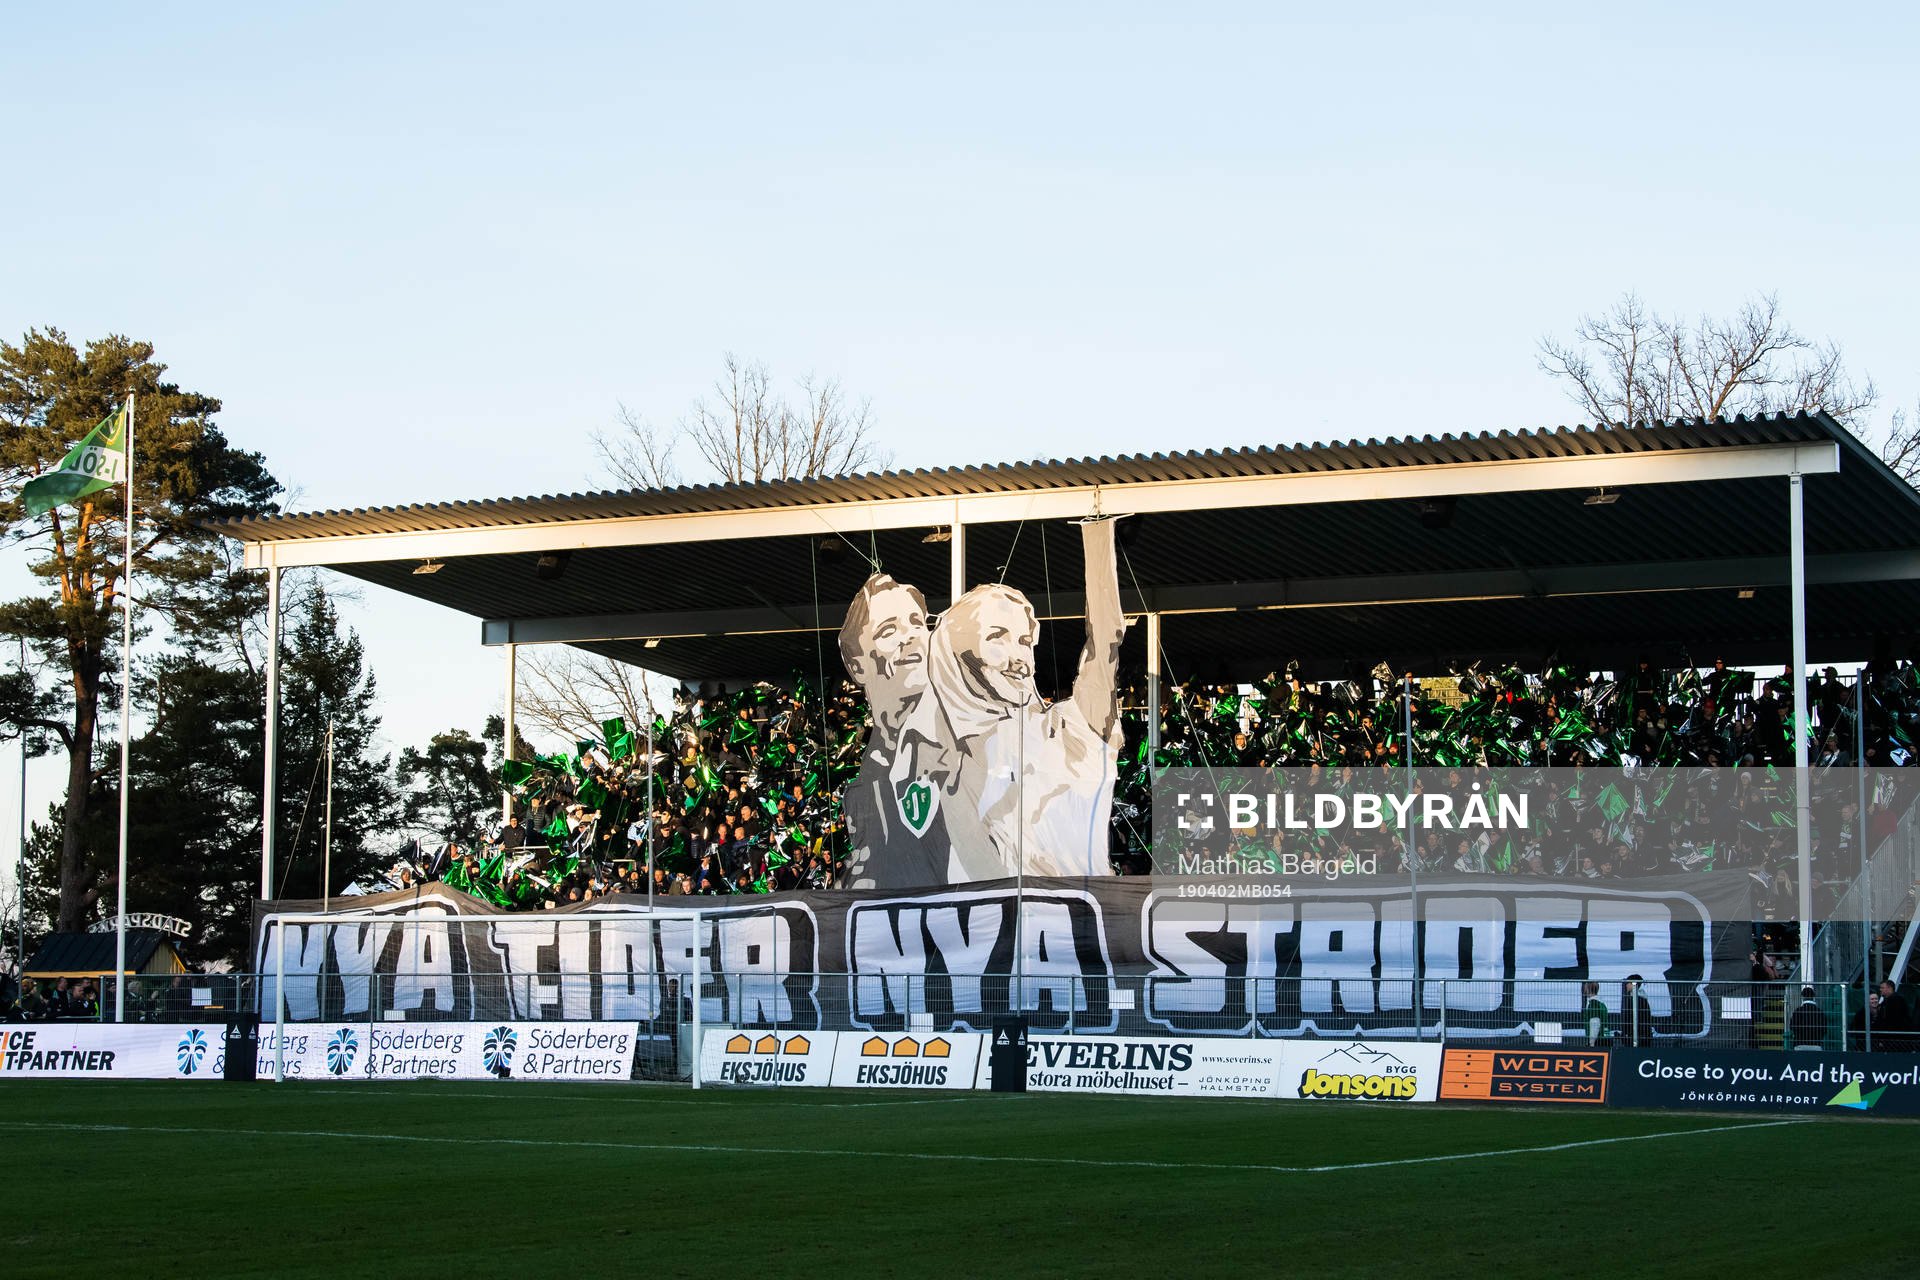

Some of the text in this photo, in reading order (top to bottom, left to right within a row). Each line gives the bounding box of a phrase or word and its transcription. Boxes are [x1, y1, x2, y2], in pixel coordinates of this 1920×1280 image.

[260, 897, 1673, 1023] NYA TIDER NYA STRIDER
[371, 1028, 464, 1053] Söderberg
[528, 1028, 629, 1054] Söderberg
[364, 1054, 457, 1074] & Partners
[523, 1053, 622, 1074] & Partners
[988, 1041, 1194, 1071] EVERINS
[1201, 1055, 1273, 1065] www.severins.se
[1500, 1057, 1599, 1074] WORK
[720, 1058, 807, 1082] EKSJÖHUS
[856, 1061, 948, 1085] EKSJÖHUS
[1198, 1075, 1271, 1085] JÖNKÖPING
[1386, 1065, 1417, 1074] BYGG
[1638, 1058, 1920, 1086] Close to you. And the worl
[1028, 1070, 1175, 1091] stora möbelhuset
[1200, 1084, 1267, 1093] HALMSTAD
[1298, 1068, 1417, 1100] Jonsons
[1498, 1082, 1595, 1094] SYSTEM
[1679, 1091, 1819, 1105] JÖNKÖPING AIRPORT
